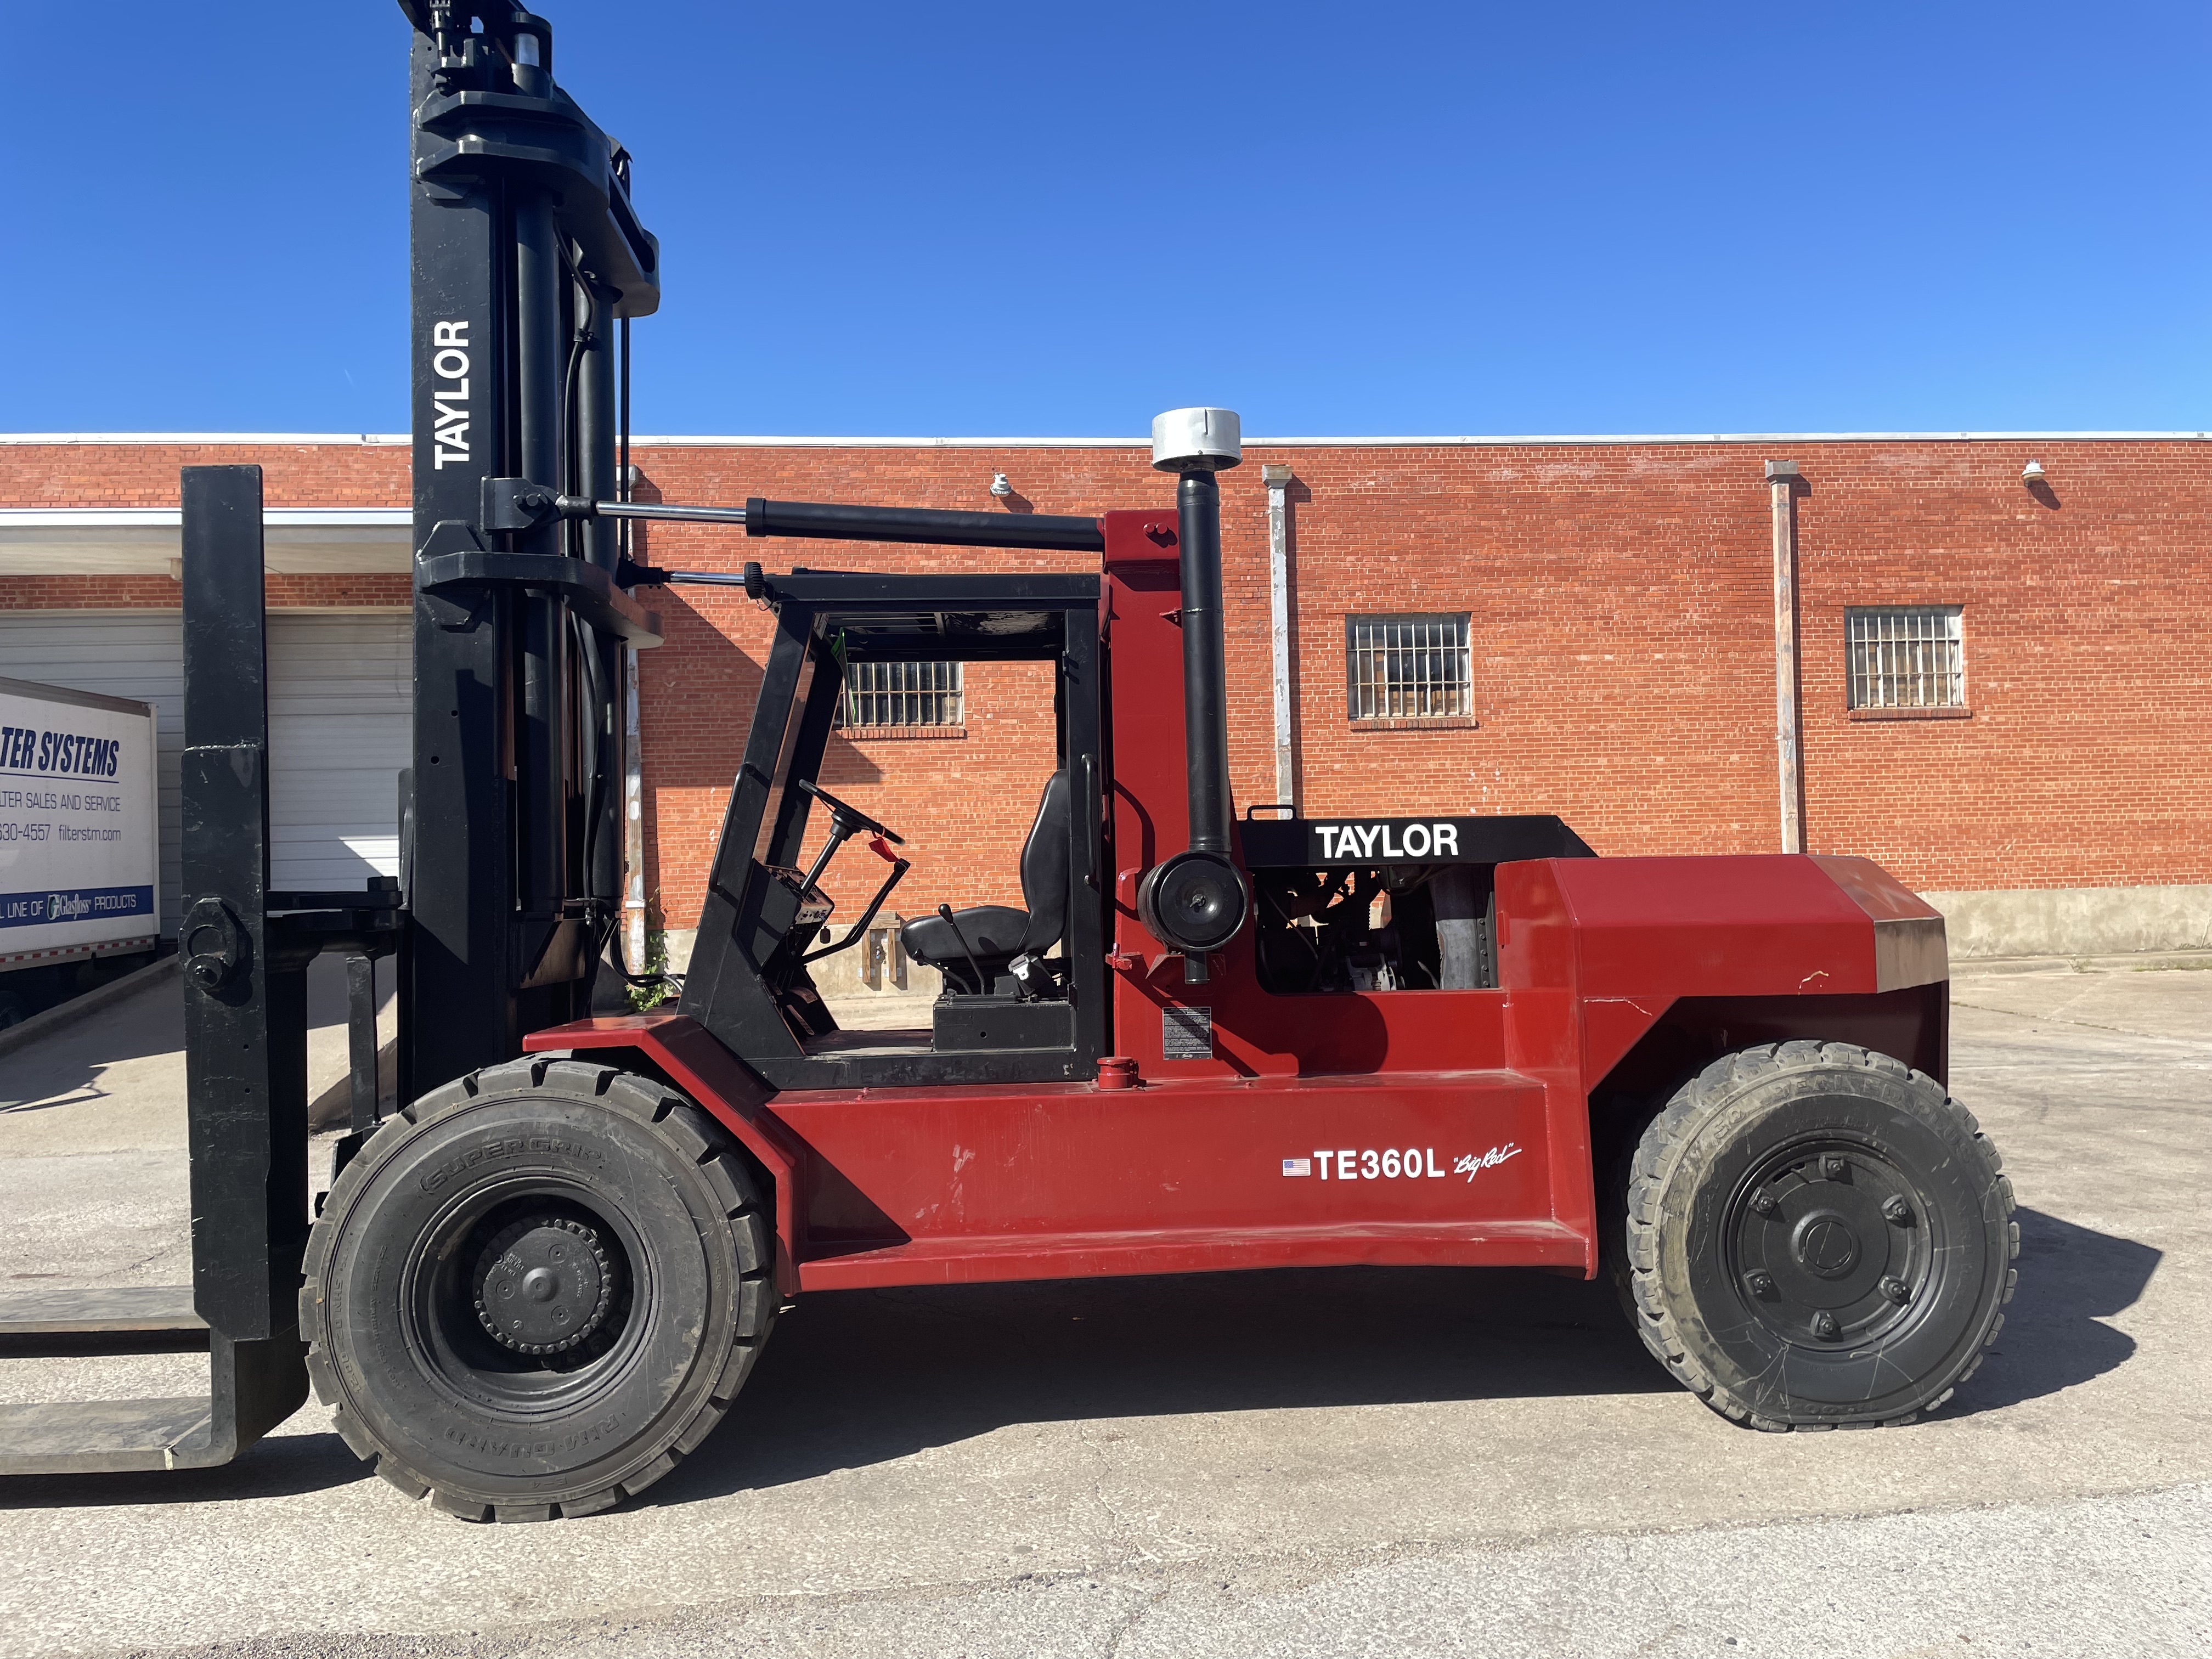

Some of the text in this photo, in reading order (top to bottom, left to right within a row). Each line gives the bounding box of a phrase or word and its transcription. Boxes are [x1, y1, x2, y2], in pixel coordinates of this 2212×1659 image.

[433, 320, 470, 470] TAYLOR
[0, 726, 119, 776] TER SYSTEMS
[26, 792, 57, 809] SALES
[60, 794, 81, 810] AND
[84, 795, 121, 812] SERVICE
[59, 824, 121, 841] filterstm.com
[1315, 823, 1459, 859] TAYLOR
[7, 901, 27, 918] LINE
[31, 900, 43, 916] OF
[94, 894, 136, 911] PRODUCTS
[420, 1137, 607, 1194] SUPER GRIP
[1313, 1148, 1446, 1181] TE360L
[714, 1252, 723, 1290] NYLON
[332, 1278, 343, 1313] NHS
[533, 1477, 567, 1489] E-4
